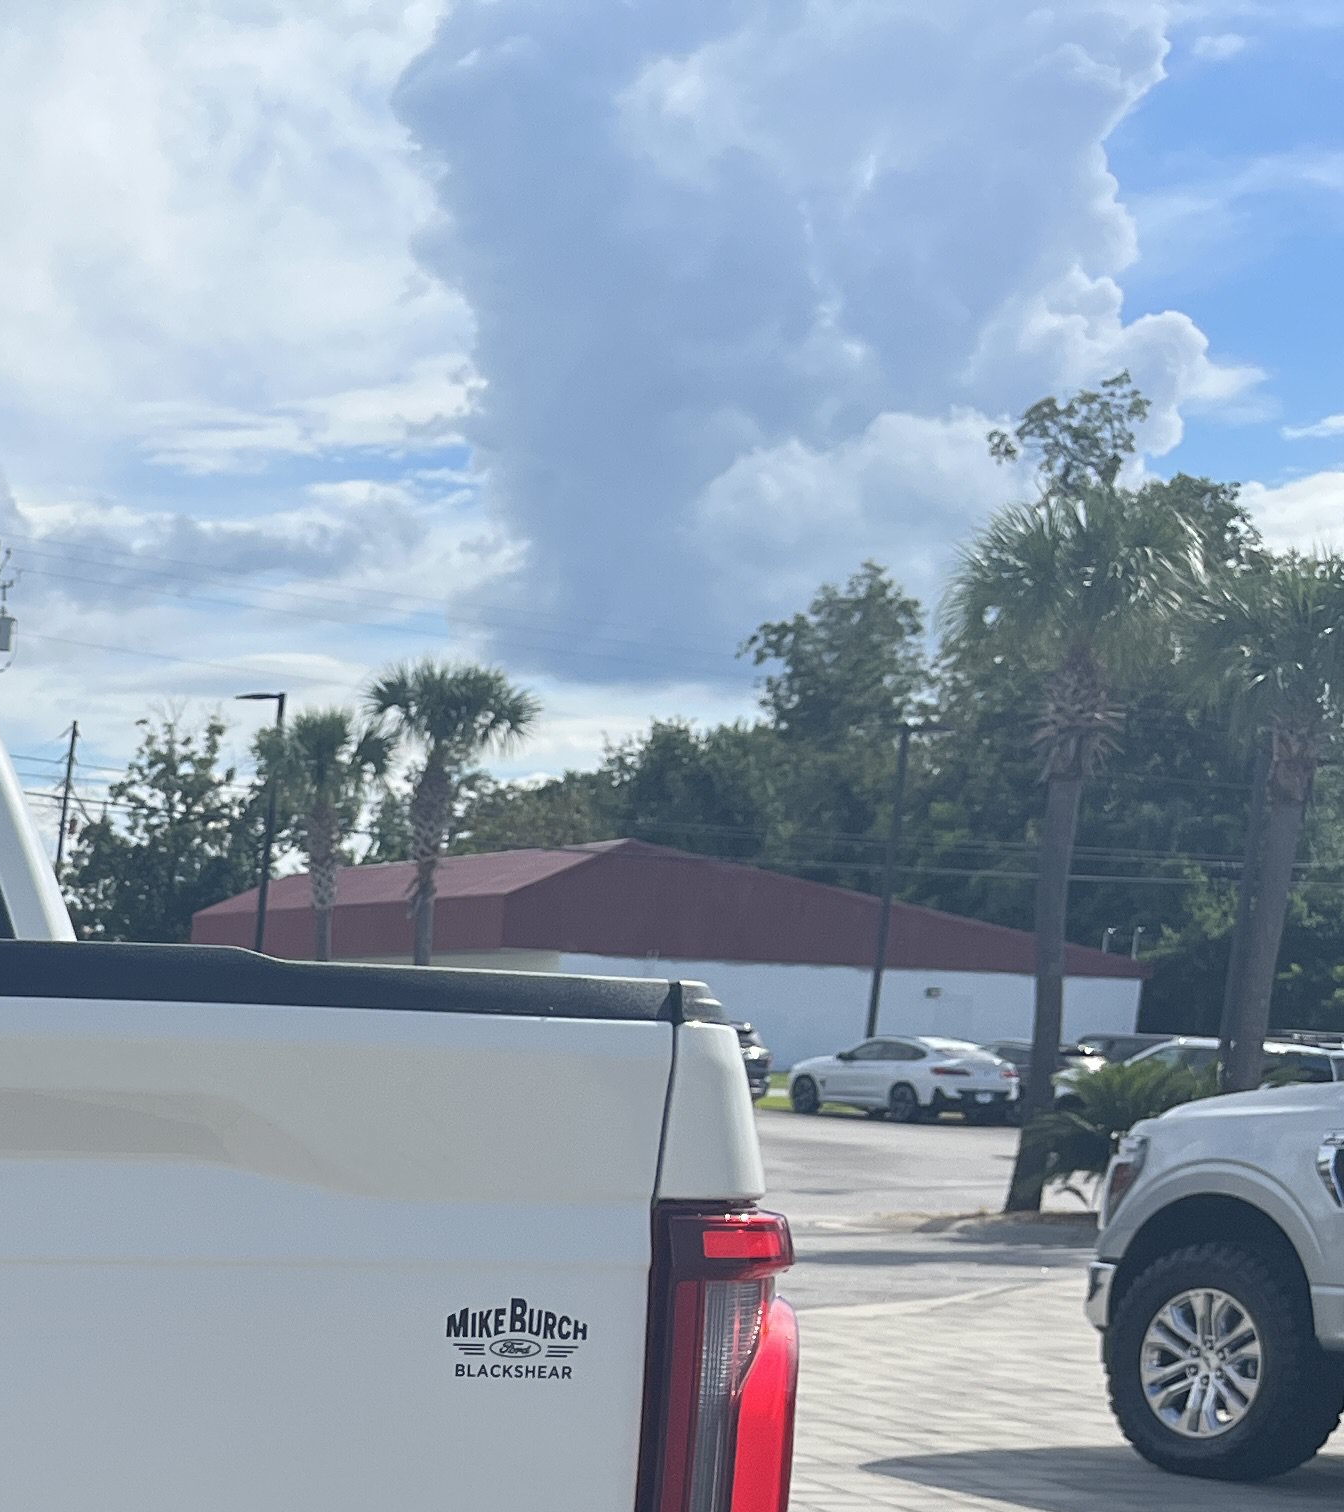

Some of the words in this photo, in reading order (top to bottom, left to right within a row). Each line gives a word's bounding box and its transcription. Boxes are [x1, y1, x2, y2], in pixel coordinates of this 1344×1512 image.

[446, 1307, 507, 1338] MIKE
[509, 1297, 588, 1341] BURCH
[498, 1341, 532, 1355] Ford
[455, 1363, 573, 1380] BLACKSHEAR
